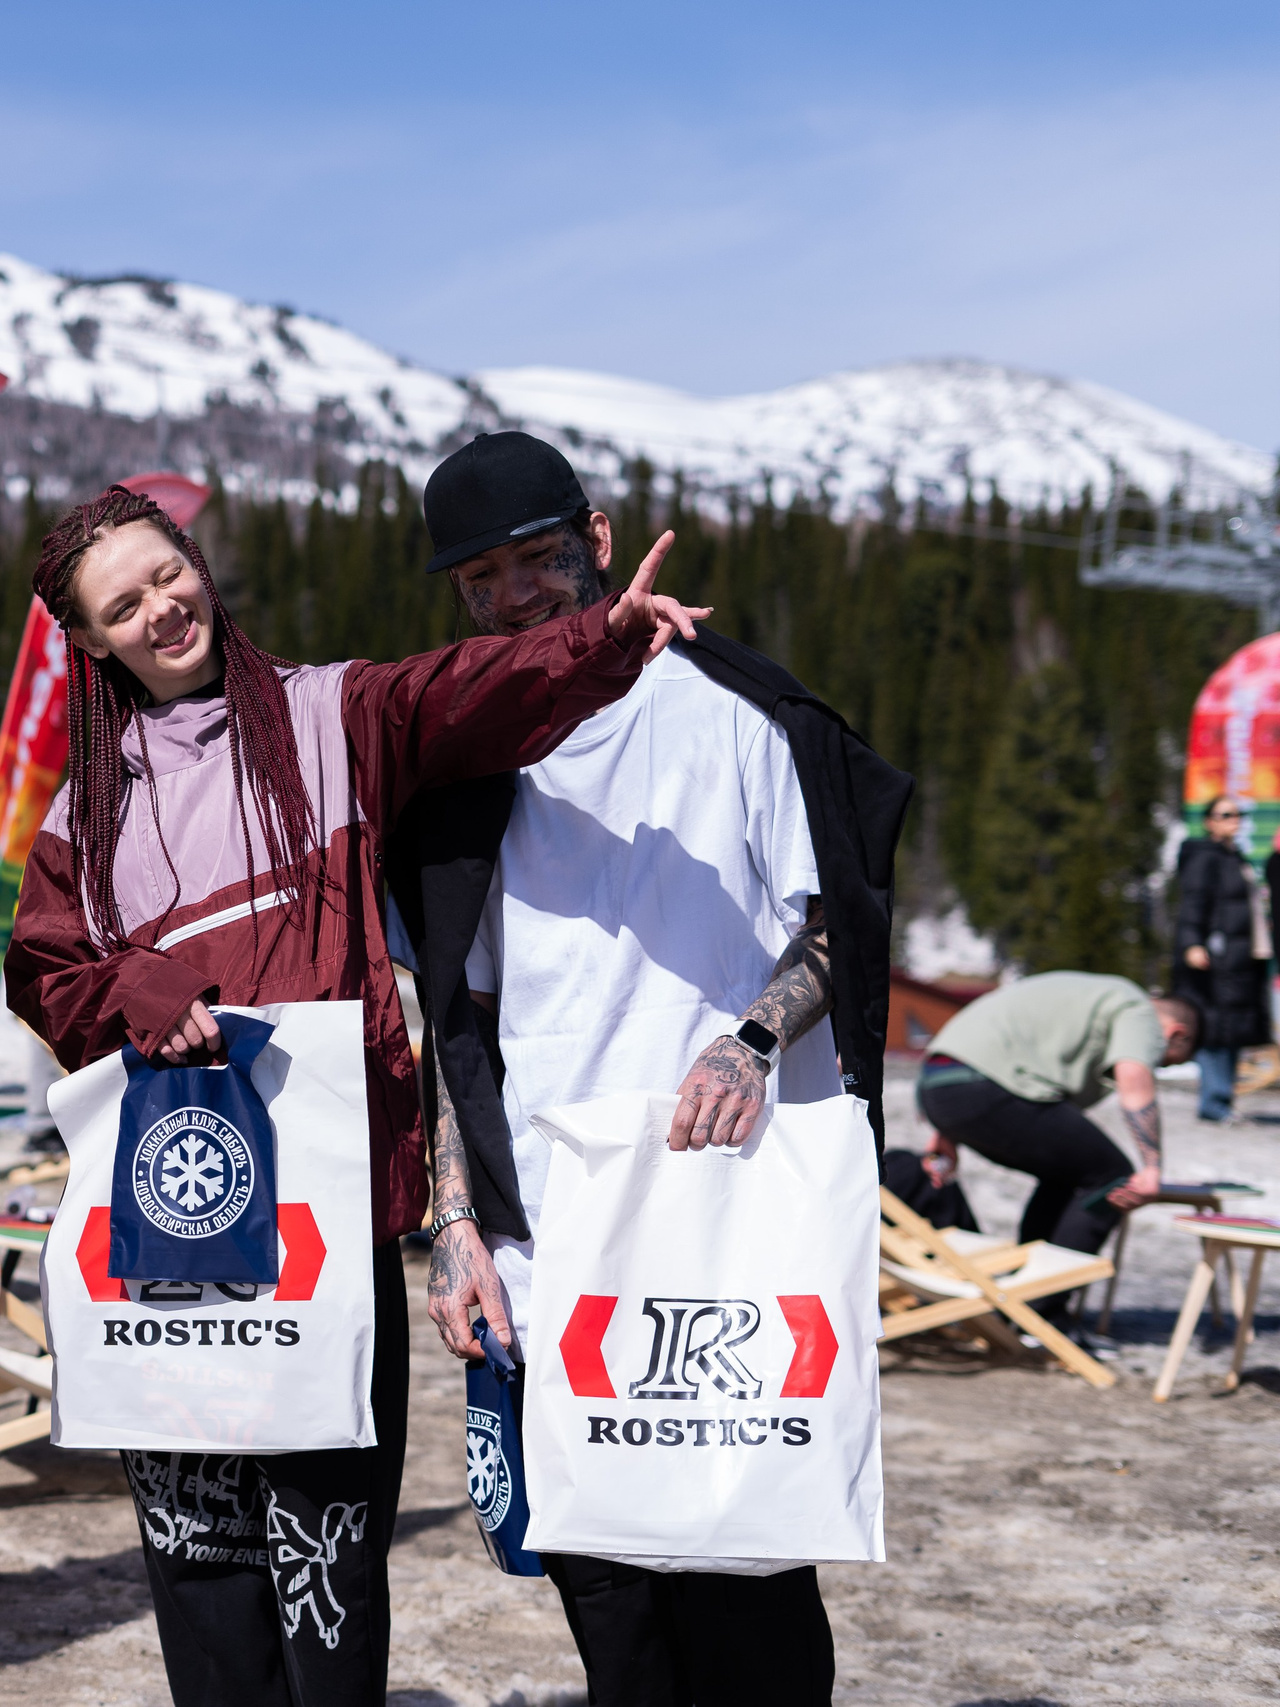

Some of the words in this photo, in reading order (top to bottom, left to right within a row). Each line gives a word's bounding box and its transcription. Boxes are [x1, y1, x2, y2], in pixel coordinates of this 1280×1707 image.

[139, 1110, 189, 1164] ХОККЕЙНЫЙ
[191, 1112, 219, 1132] КЛУБ
[218, 1126, 248, 1169] СИБИРЬ
[136, 1179, 212, 1235] НОВОСИБИРСКАЯ
[212, 1185, 249, 1229] ОБЛАСТЬ
[103, 1319, 301, 1347] ROSTIC'S
[467, 1411, 493, 1428] КЛУБ
[587, 1416, 812, 1447] ROSTIC'S
[491, 1481, 509, 1523] ОБЛАСТЬ
[185, 1541, 231, 1562] YOUR
[232, 1548, 270, 1567] ENE
